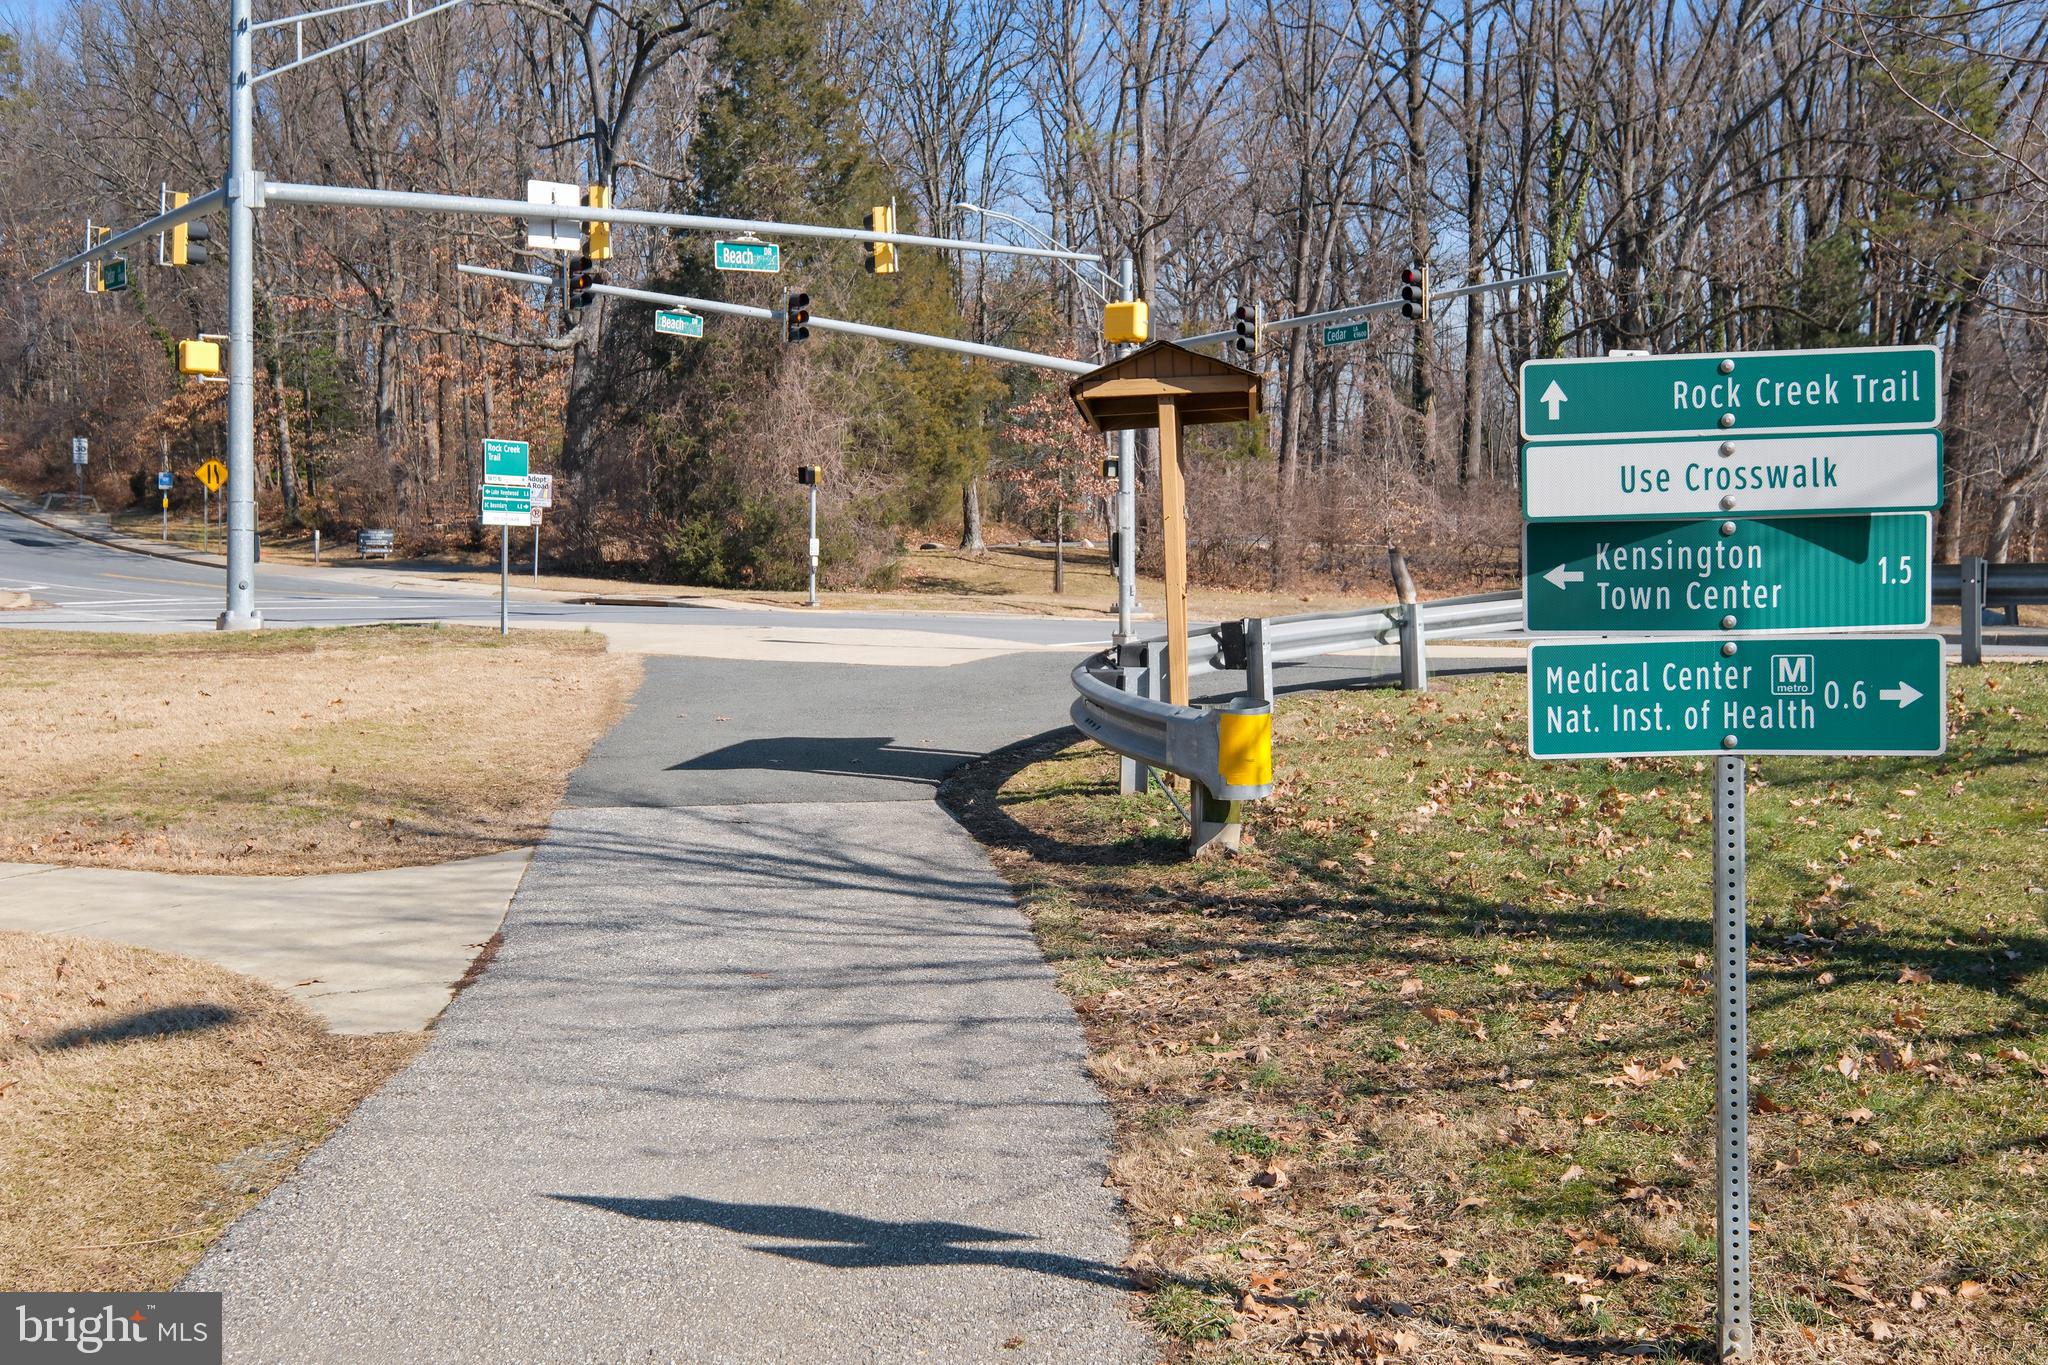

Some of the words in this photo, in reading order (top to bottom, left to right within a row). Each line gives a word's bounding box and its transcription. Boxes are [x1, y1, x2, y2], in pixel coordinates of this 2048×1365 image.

[723, 247, 753, 265] Beach
[763, 247, 772, 256] DR
[661, 315, 684, 331] Beach
[1327, 329, 1346, 342] Cedar
[1674, 378, 1741, 410] Rock
[1756, 374, 1839, 407] Creek
[1852, 370, 1920, 403] Trail
[488, 443, 502, 453] Rock
[503, 444, 521, 453] Creek
[488, 452, 501, 461] Trail
[528, 475, 547, 484] Adopt
[1620, 465, 1670, 494] Use
[1685, 457, 1837, 492] Crosswalk
[1596, 540, 1762, 578] Kensington
[1878, 556, 1912, 585] 1.5
[1597, 582, 1670, 610] Town
[1686, 580, 1782, 609] Center
[1546, 661, 1650, 694] Medical
[1662, 661, 1752, 691] Center
[1779, 658, 1806, 683] M
[1777, 684, 1809, 692] metro
[1825, 680, 1866, 709] 0.6
[1547, 704, 1599, 734] Nat.
[1613, 703, 1671, 732] Inst.
[1684, 700, 1710, 730] of
[1724, 700, 1815, 729] Health
